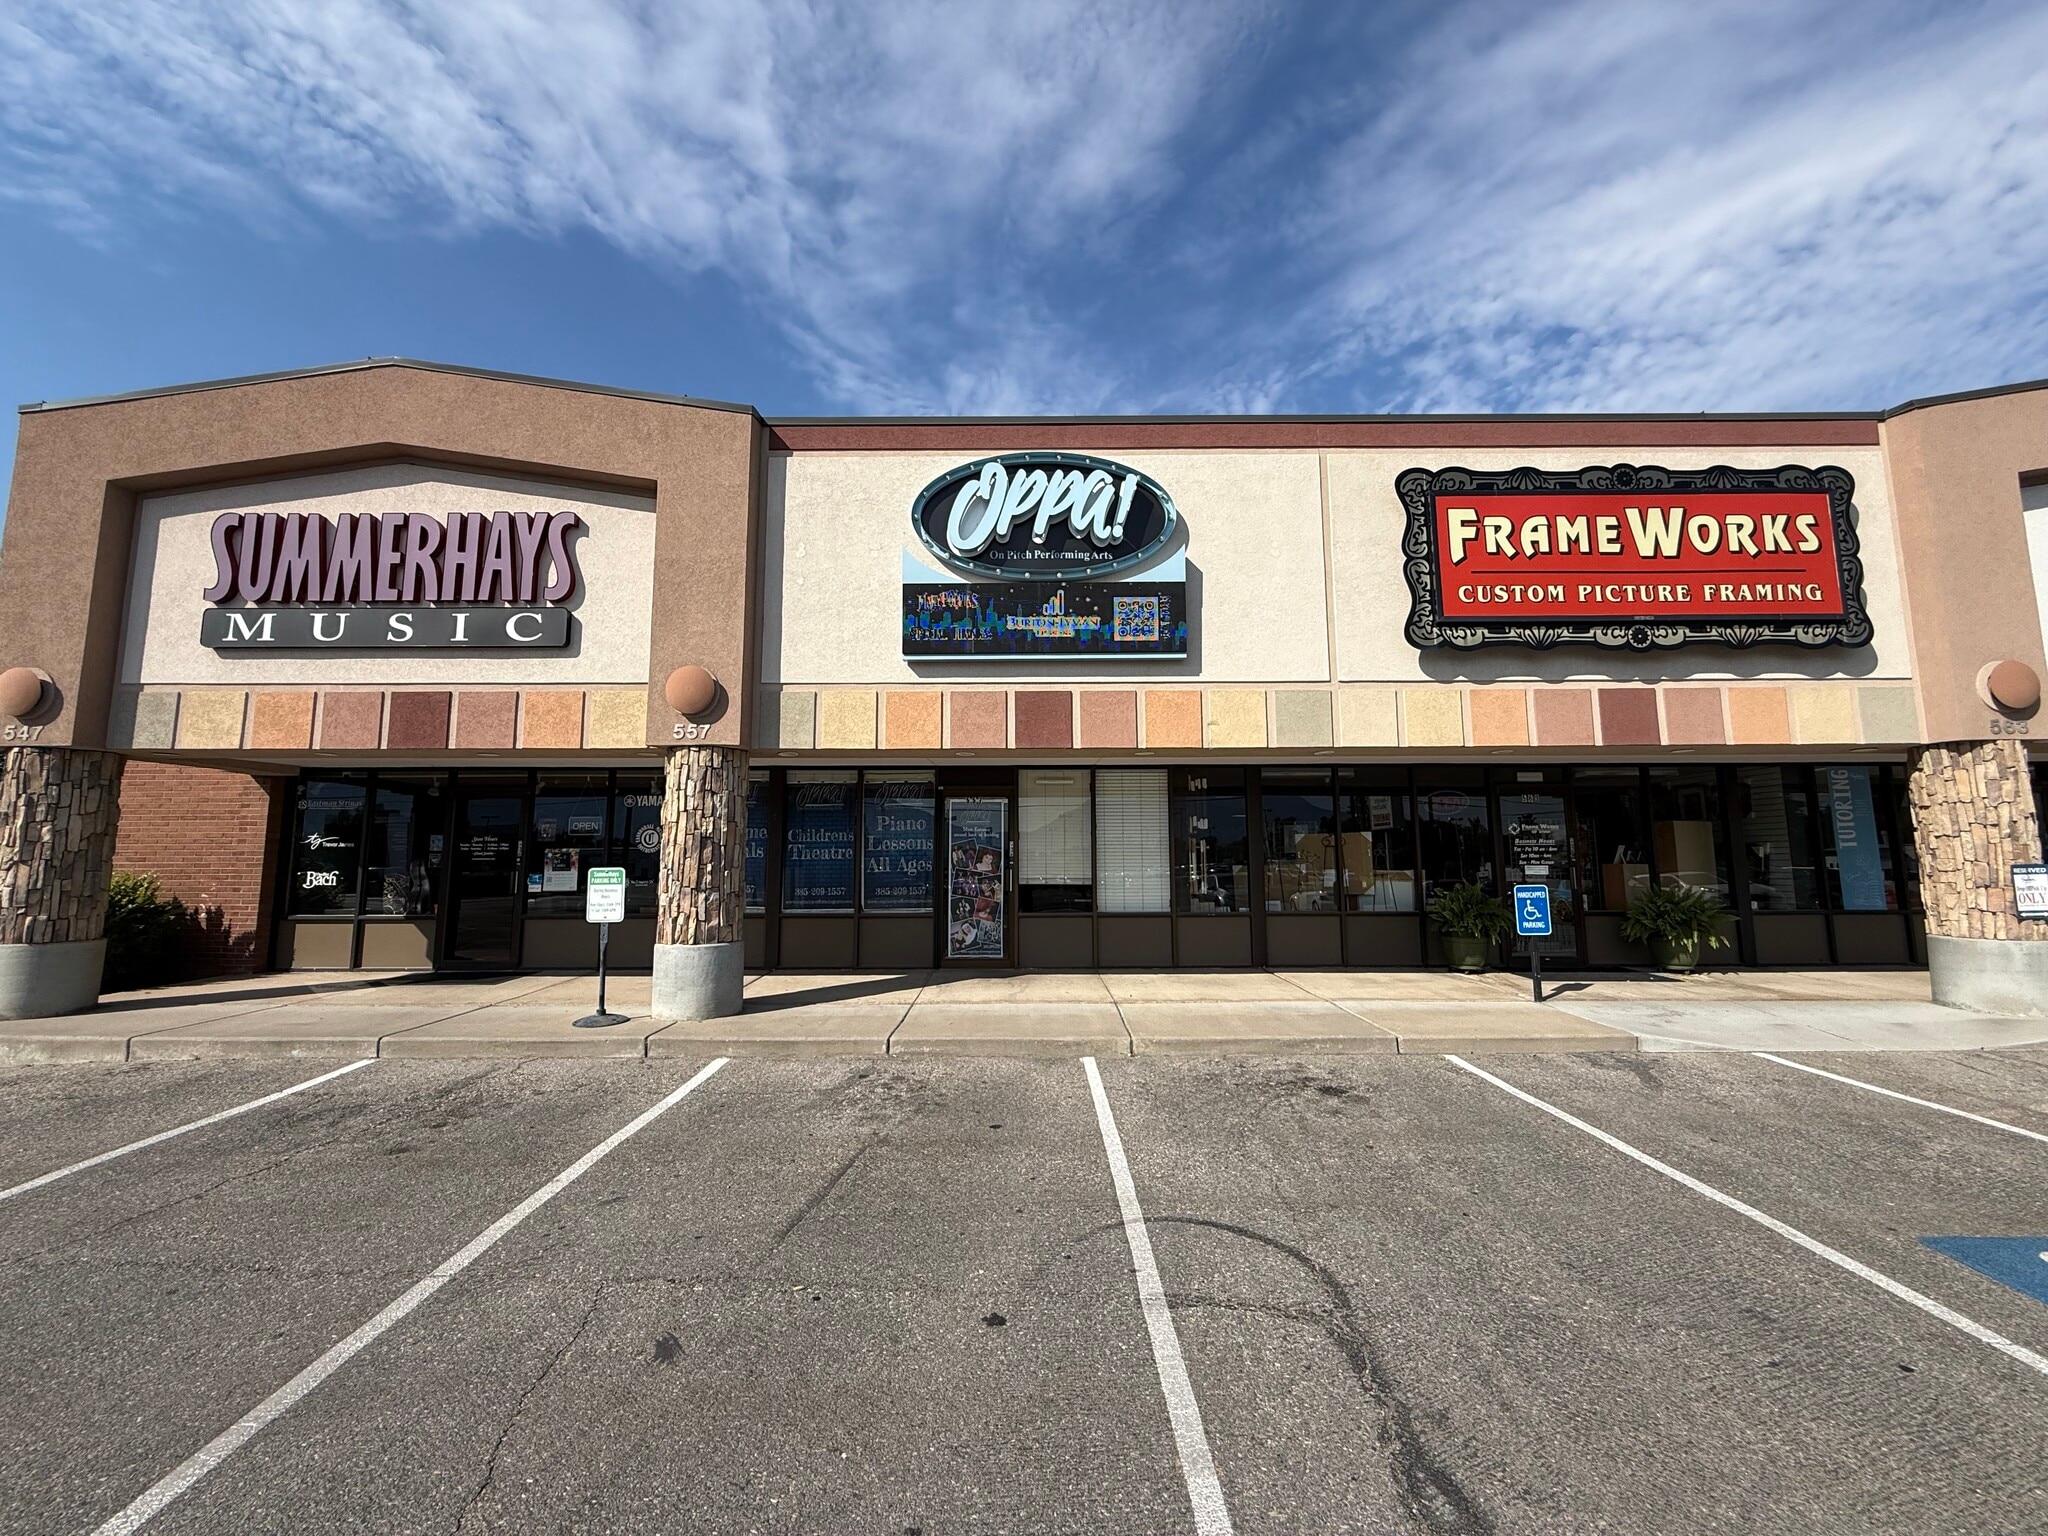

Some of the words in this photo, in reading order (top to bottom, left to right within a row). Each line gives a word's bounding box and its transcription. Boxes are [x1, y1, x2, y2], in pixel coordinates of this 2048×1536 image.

[947, 462, 1139, 556] Oppa!
[203, 511, 579, 603] SUMMERHAYS
[990, 550, 1005, 560] On
[1007, 550, 1033, 560] Pitch
[1034, 550, 1091, 562] Performing
[1091, 550, 1113, 561] Arts
[1458, 584, 1566, 604] CUSTOM
[1578, 584, 1692, 603] PICTURE
[1703, 583, 1824, 602] FRAMING
[221, 612, 543, 643] MUSIC
[3, 724, 45, 742] 547
[672, 723, 712, 740] 557
[1989, 718, 2030, 736] 563
[1831, 768, 1858, 850] TUTORING
[572, 821, 599, 831] OPEN
[876, 815, 927, 831] Piano
[787, 828, 854, 842] Children's
[866, 835, 934, 851] Lessons
[788, 844, 854, 860] Theatre
[866, 856, 892, 873] All
[897, 856, 933, 876] Ages
[302, 870, 340, 889] Bach
[1517, 891, 1546, 899] HANDICAPPED
[2018, 892, 2046, 904] ONLY
[1522, 921, 1546, 929] PARKING
